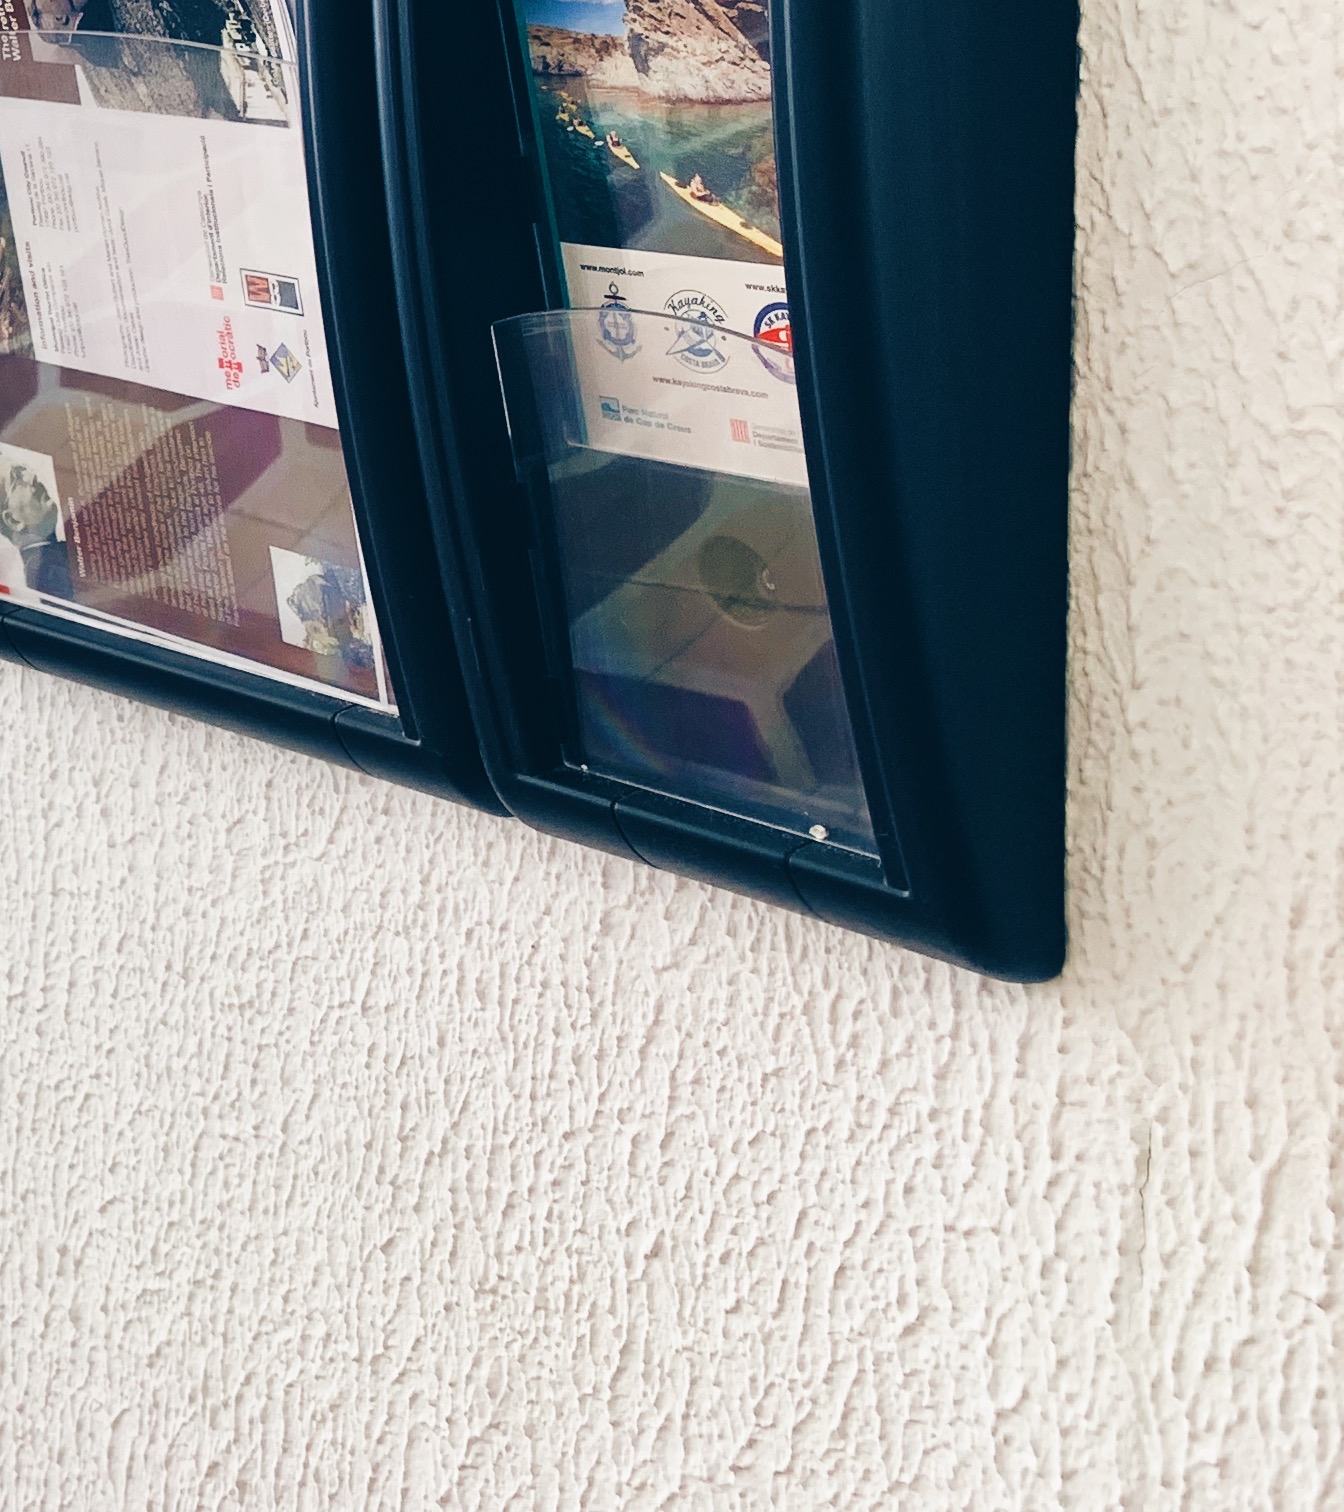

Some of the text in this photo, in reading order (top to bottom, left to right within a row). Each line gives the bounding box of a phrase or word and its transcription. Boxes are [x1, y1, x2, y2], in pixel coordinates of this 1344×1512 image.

[0, 34, 13, 60] The
[28, 270, 37, 289] and
[668, 295, 725, 324] Kayaking
